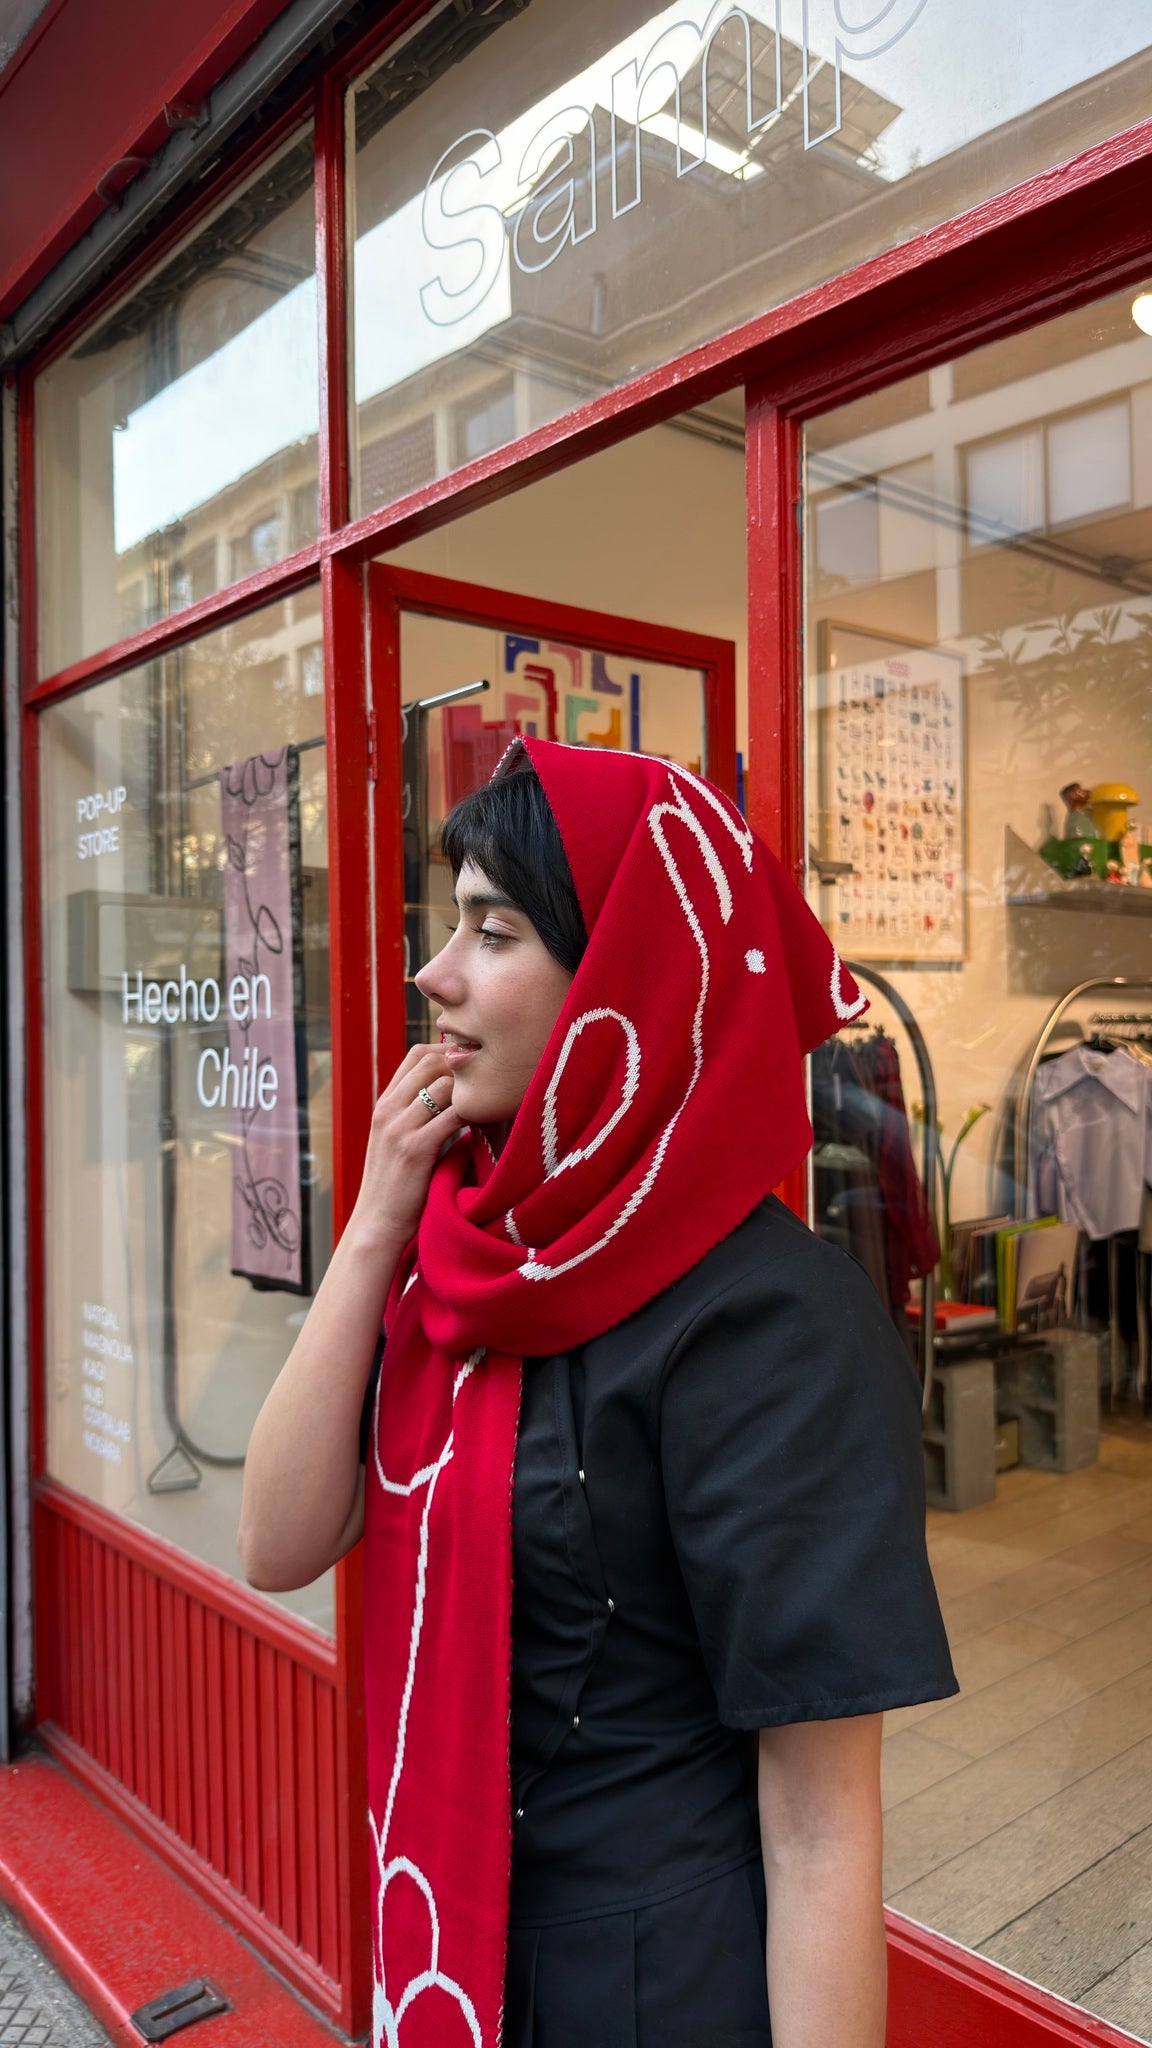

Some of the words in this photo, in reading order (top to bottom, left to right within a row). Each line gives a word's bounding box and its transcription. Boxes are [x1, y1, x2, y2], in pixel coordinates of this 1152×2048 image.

[77, 785, 127, 823] POP-UP
[77, 826, 119, 860] STORE
[121, 964, 221, 1024] Hecho
[228, 973, 272, 1022] en
[197, 1046, 279, 1111] Chile
